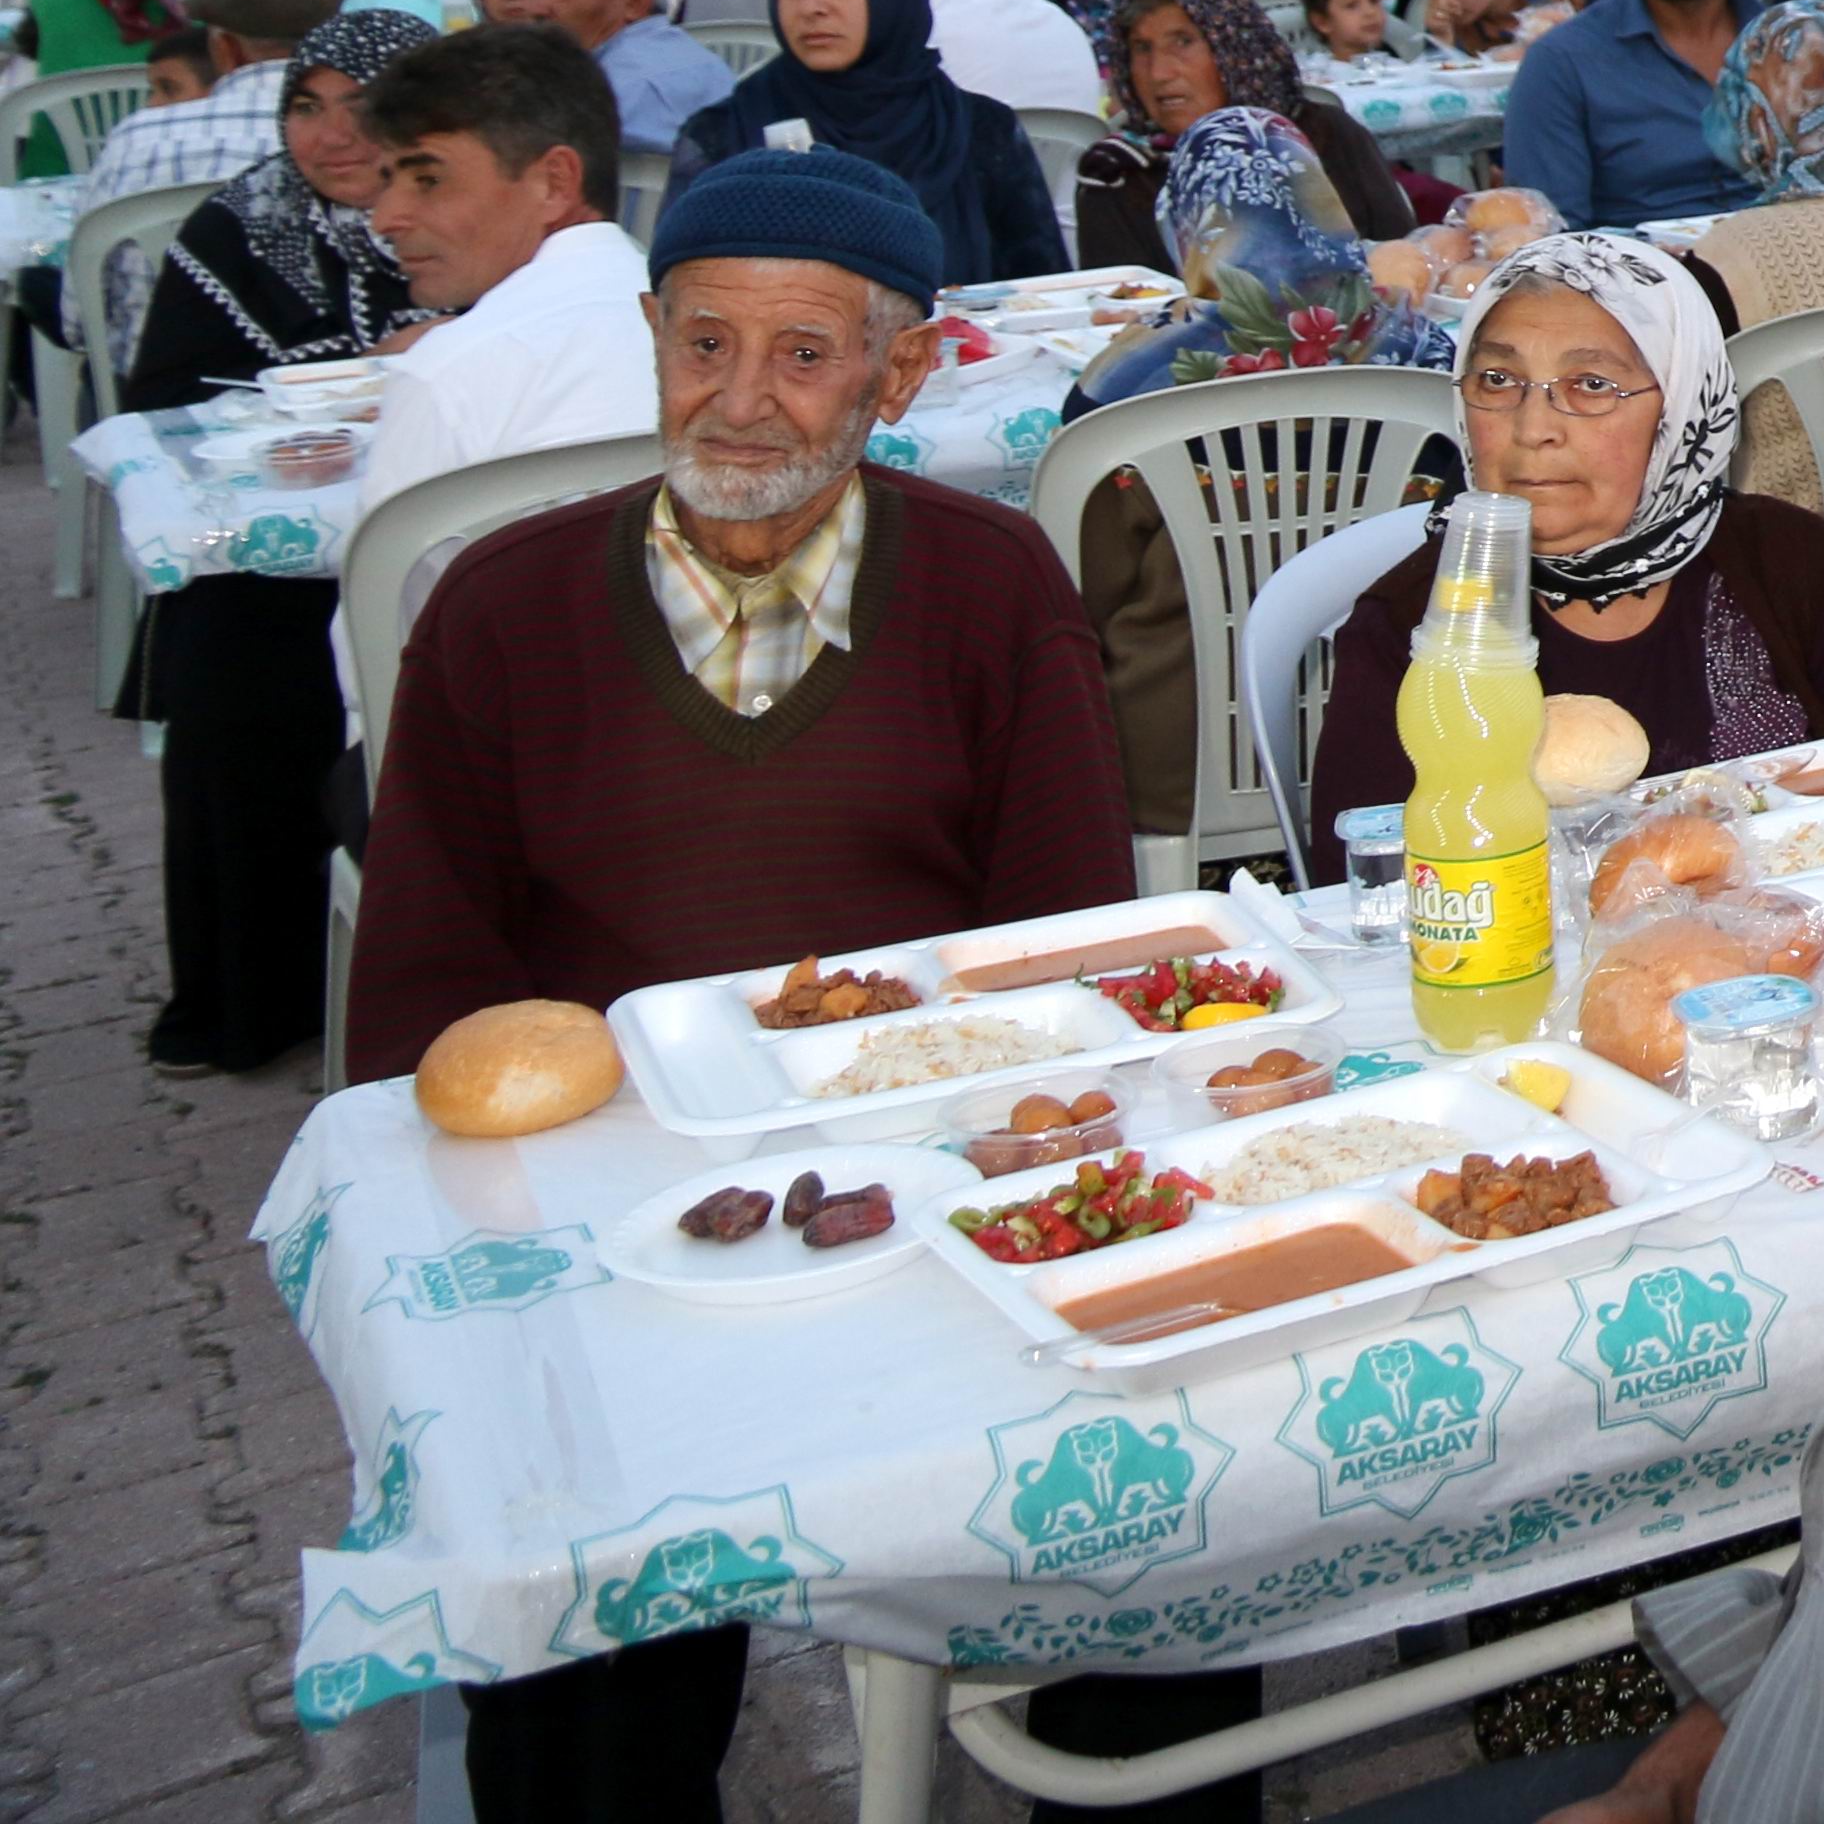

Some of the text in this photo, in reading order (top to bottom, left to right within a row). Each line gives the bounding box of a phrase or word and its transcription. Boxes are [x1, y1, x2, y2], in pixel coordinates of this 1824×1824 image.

[1411, 878, 1494, 929] udağ
[1411, 923, 1478, 941] ONATA
[1614, 1347, 1749, 1404] AKSARAY
[1336, 1424, 1481, 1486] AKSARAY
[1029, 1508, 1186, 1576] AKSARAY
